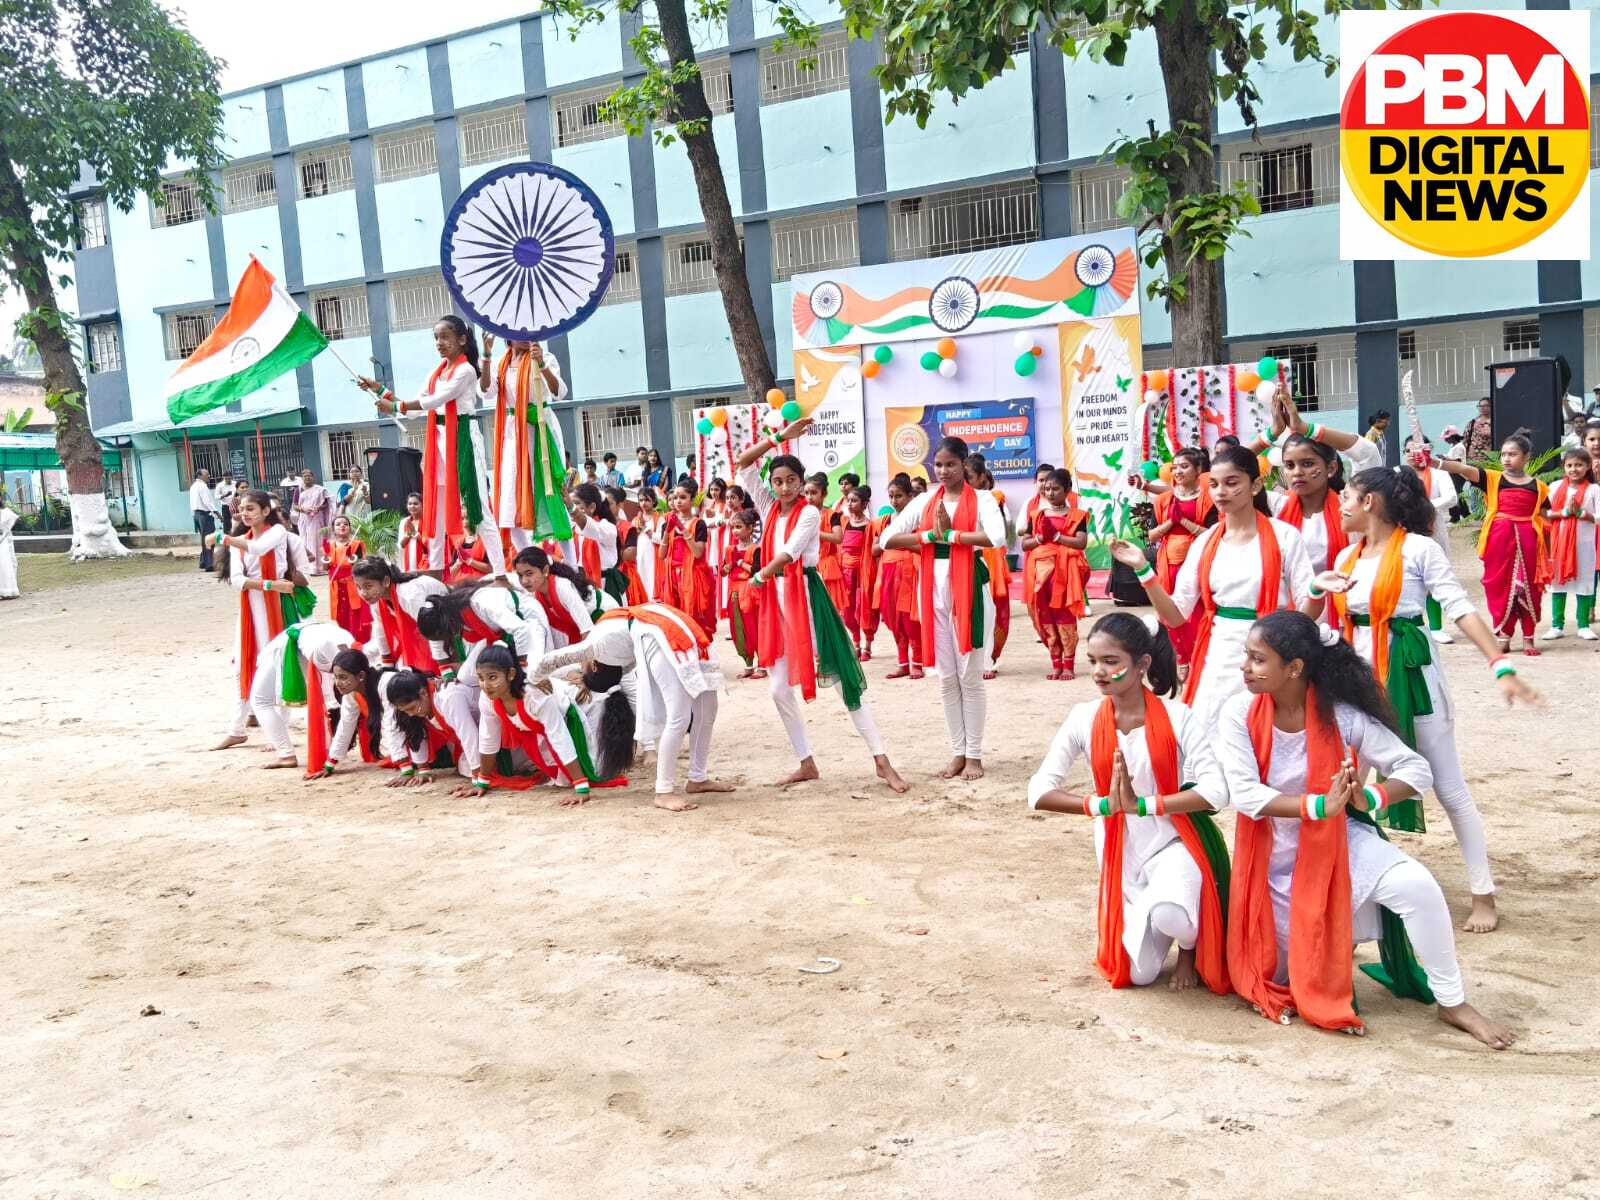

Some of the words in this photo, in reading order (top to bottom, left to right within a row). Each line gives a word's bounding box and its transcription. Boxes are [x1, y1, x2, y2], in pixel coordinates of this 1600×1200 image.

[1081, 393, 1118, 405] FREEDOM
[820, 410, 839, 420] HAPPY
[945, 410, 971, 419] HAPPY
[1075, 409, 1084, 418] IN
[1085, 408, 1101, 417] OUR
[1102, 406, 1127, 416] MINDS
[807, 421, 856, 436] INDEPENDENCE
[948, 422, 1023, 435] INDEPENDENCE
[1090, 420, 1113, 431] PRIDE
[824, 439, 837, 449] DAY
[1003, 438, 1022, 447] DAY
[1076, 436, 1084, 445] IN
[1085, 434, 1100, 445] OUR
[1101, 432, 1129, 443] HEARTS
[993, 457, 1034, 469] SCHOOL
